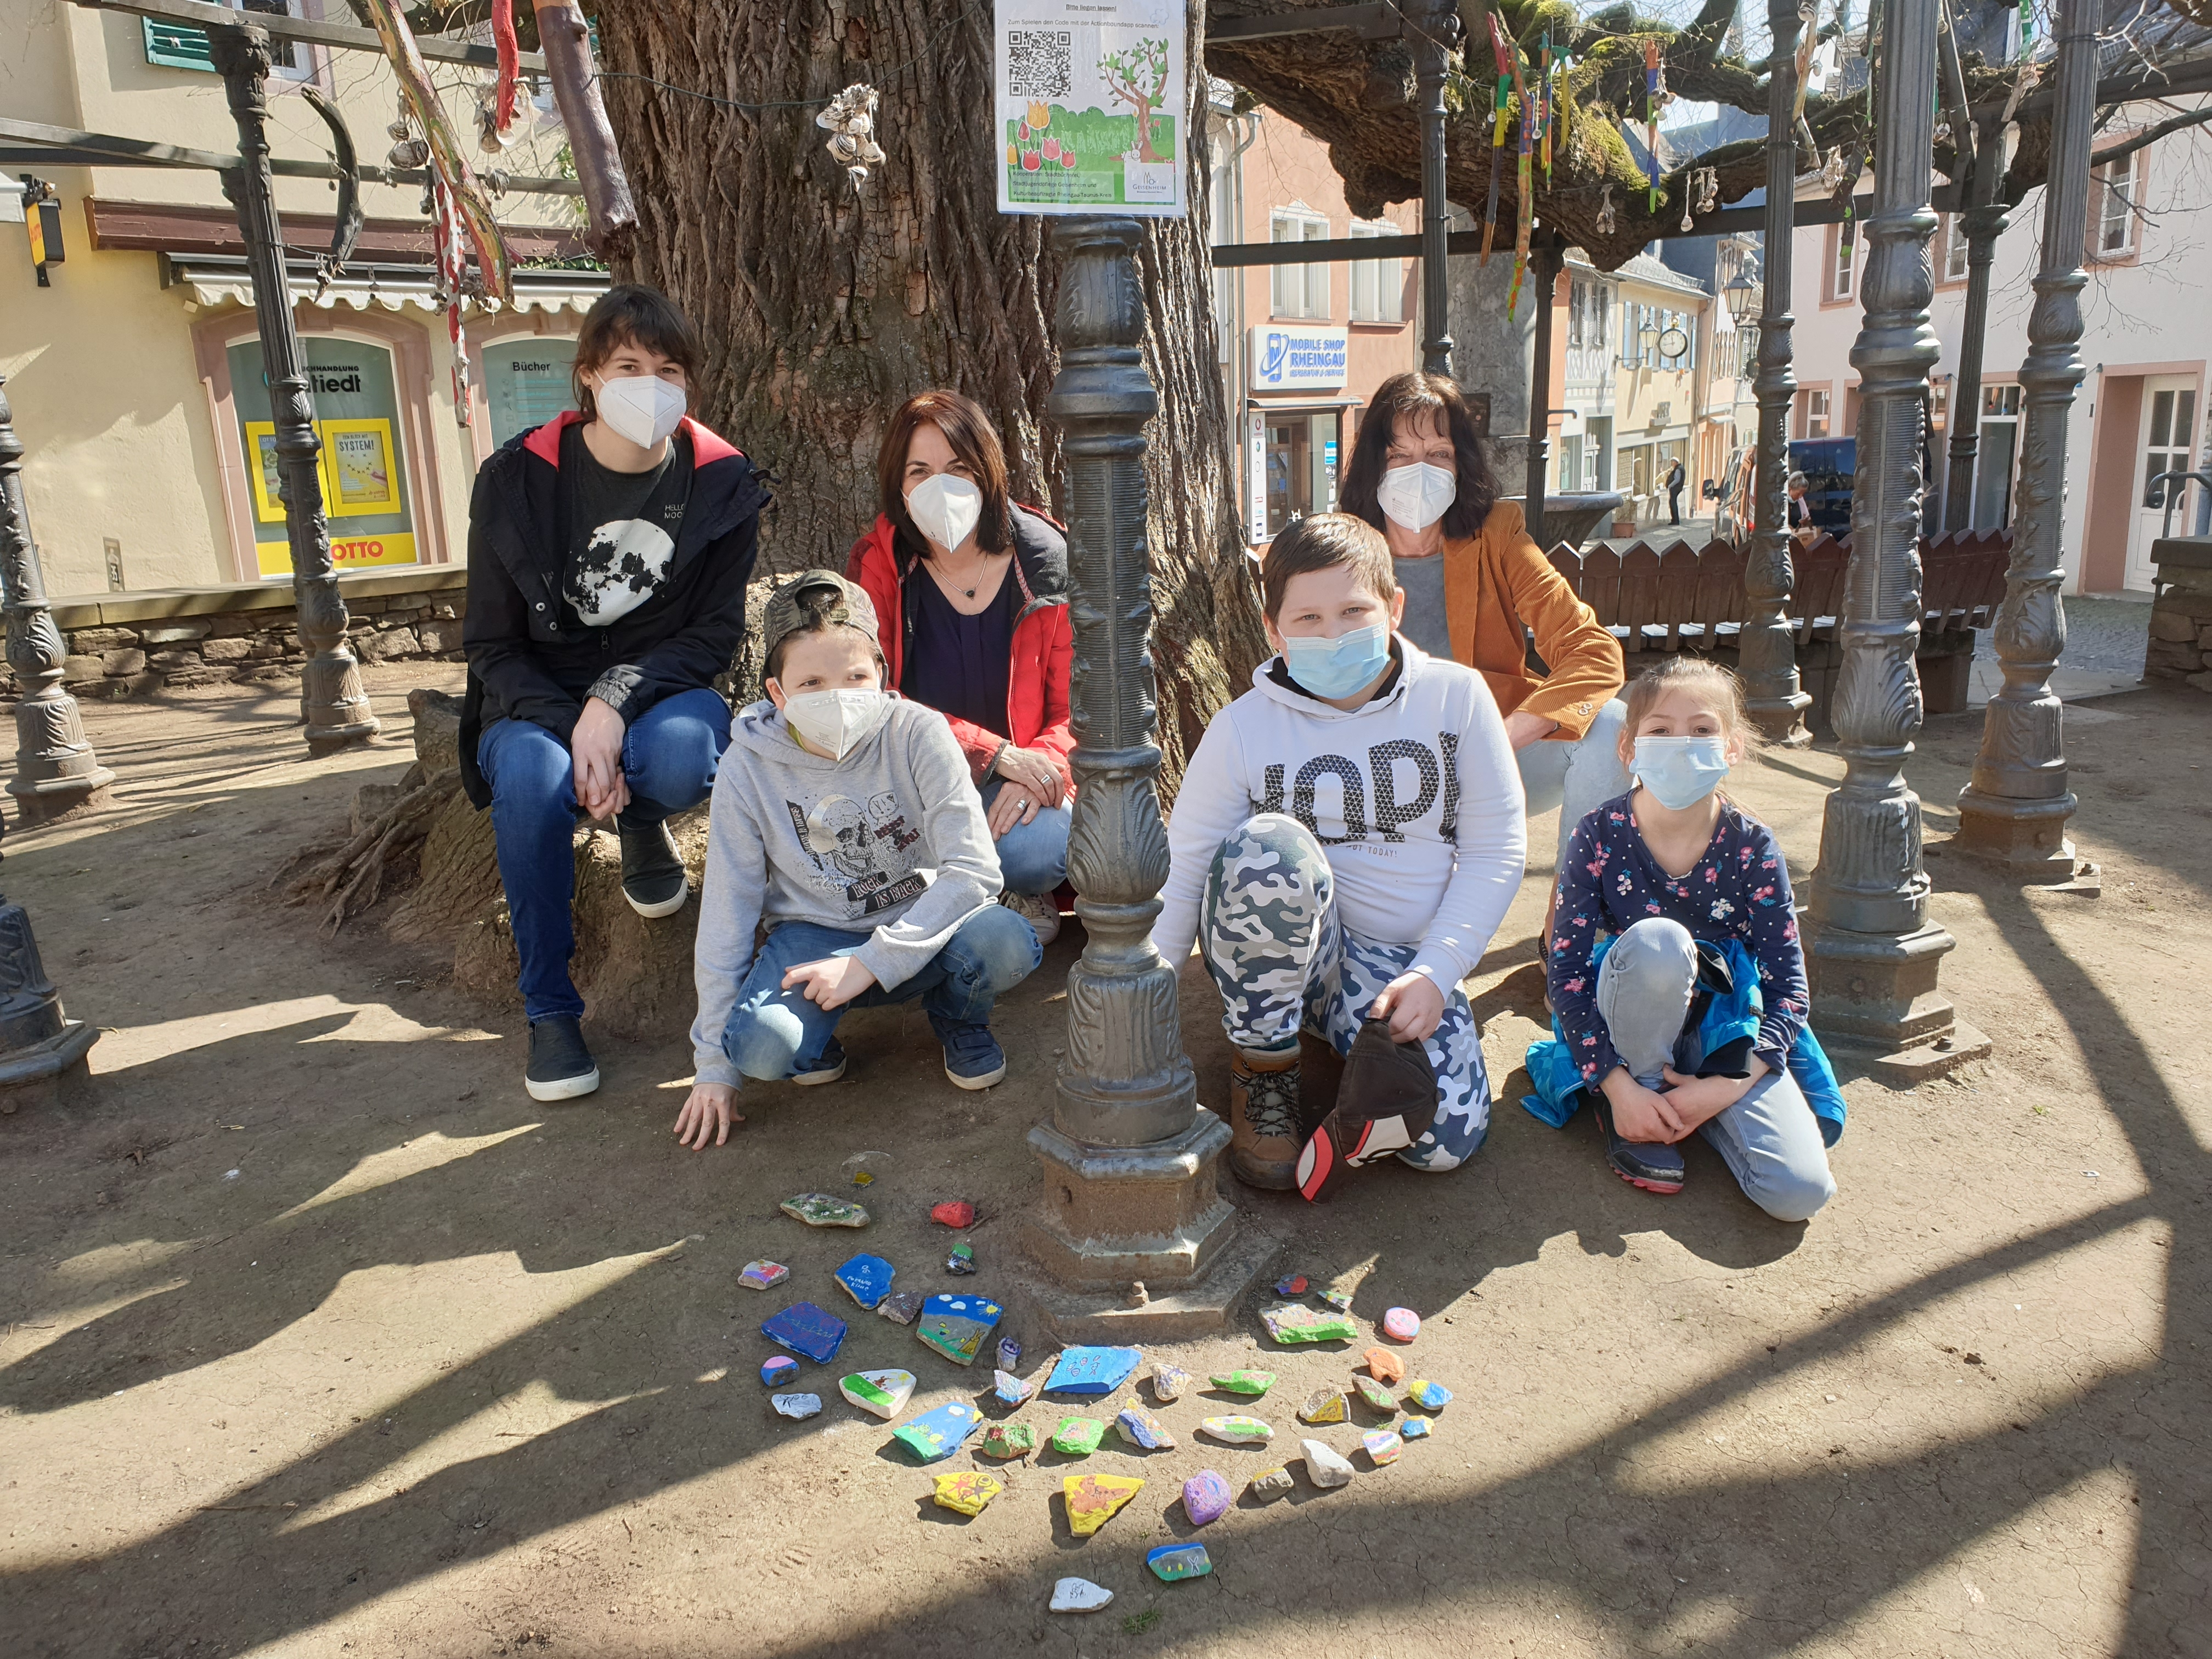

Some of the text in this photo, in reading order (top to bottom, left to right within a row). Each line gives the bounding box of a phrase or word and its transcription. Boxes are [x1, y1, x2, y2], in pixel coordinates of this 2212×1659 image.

[1290, 338, 1345, 351] MOBILE SHOP
[513, 361, 550, 371] Bücher
[1290, 352, 1345, 368] RHEINGAU
[1290, 369, 1319, 377] REPARATUR
[305, 374, 361, 393] tiedt
[339, 440, 374, 452] SYSTEM!
[331, 541, 383, 561] OTTO
[1368, 846, 1397, 857] TODAY!
[851, 875, 883, 897] ROCK
[875, 878, 922, 909] IS BACK
